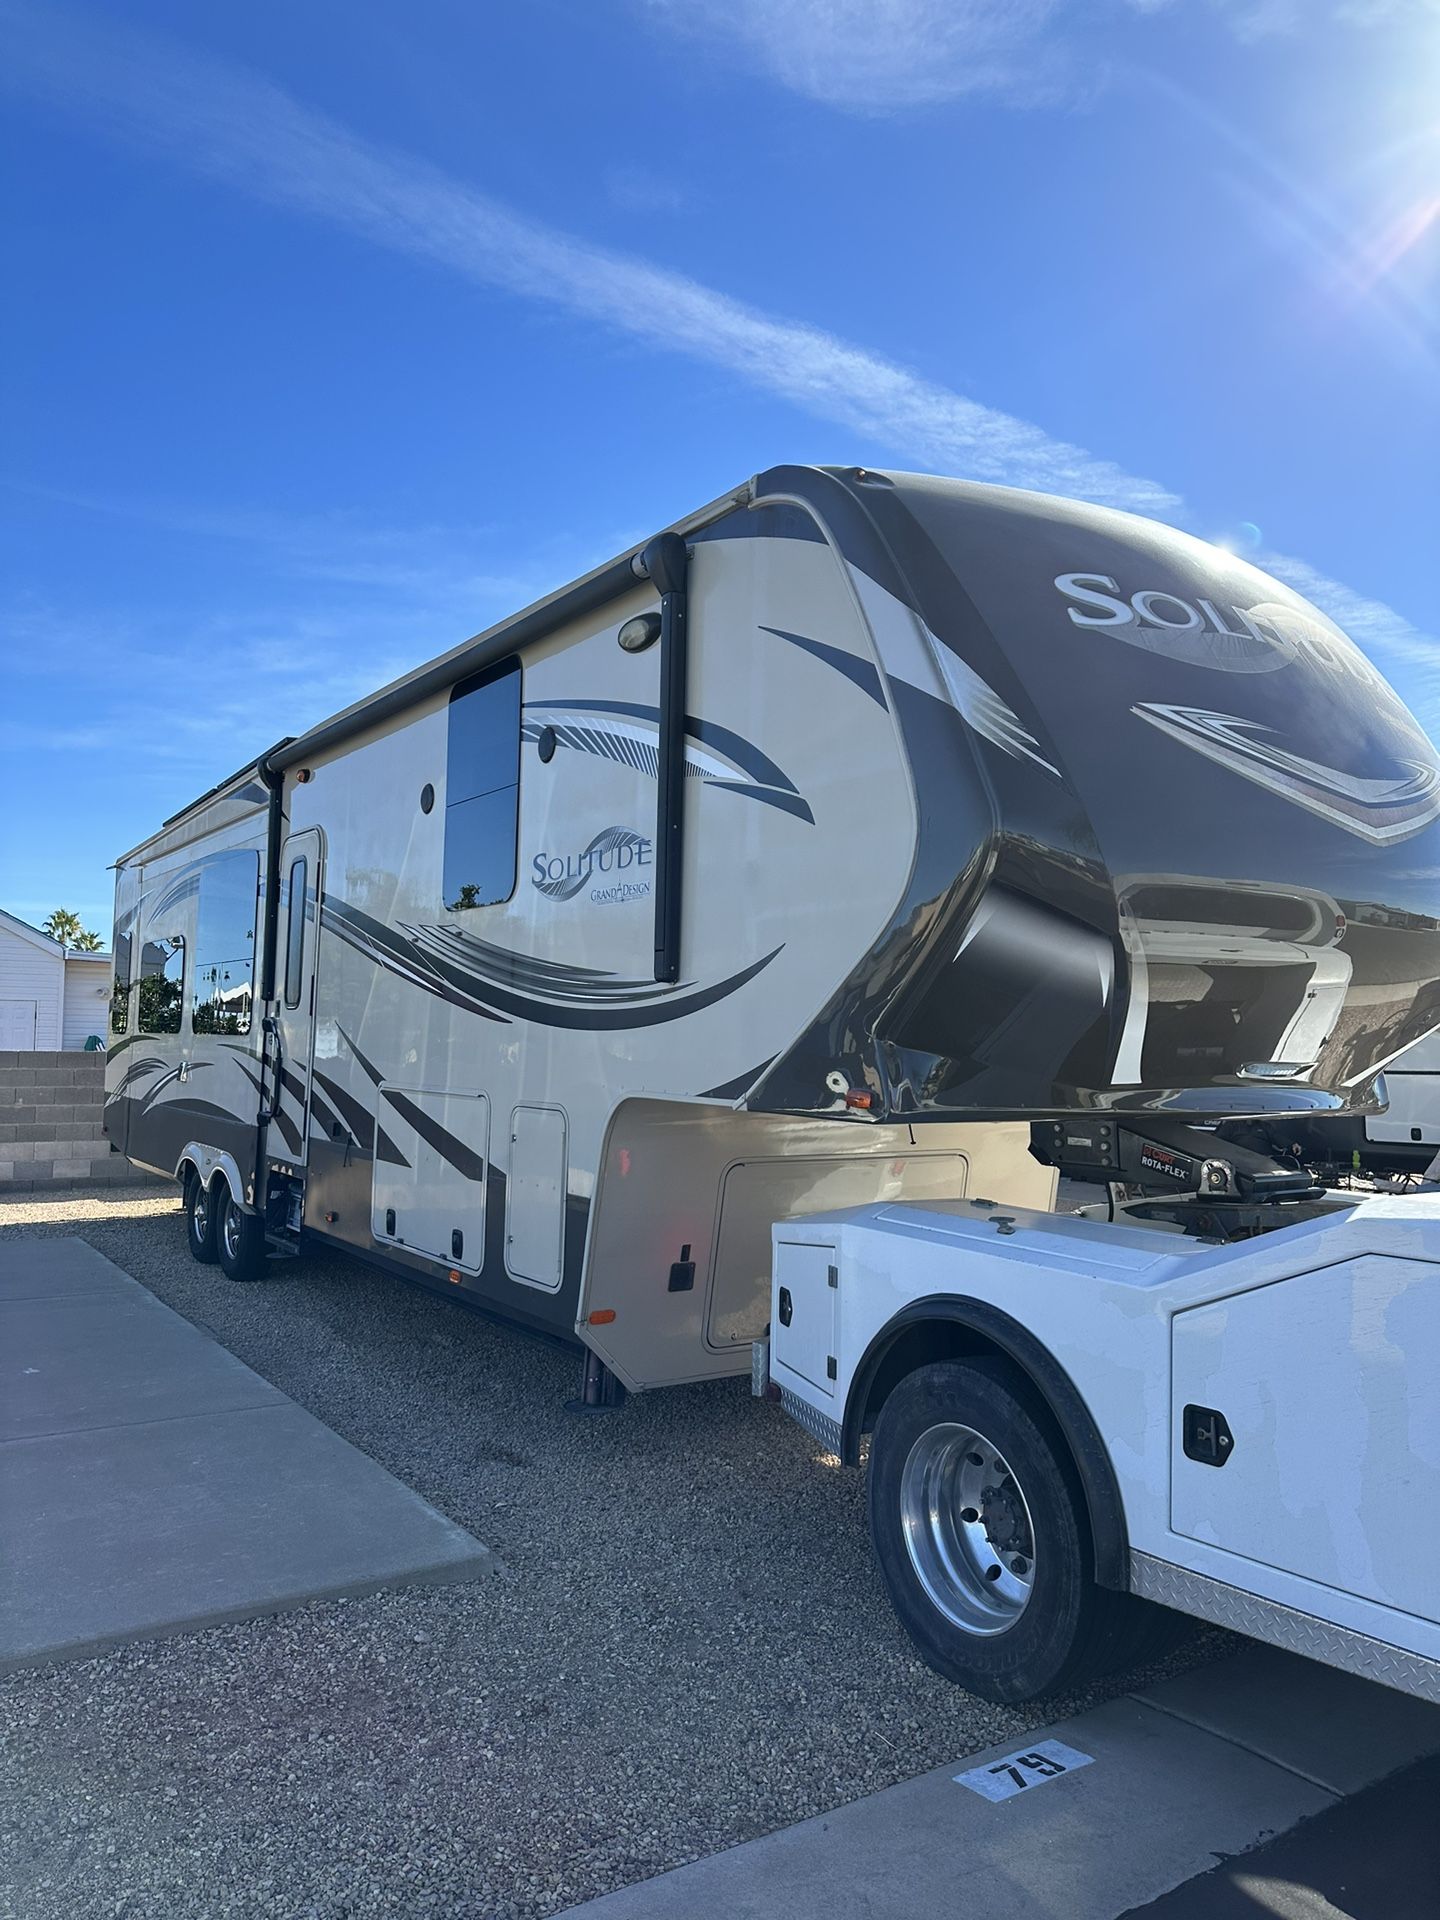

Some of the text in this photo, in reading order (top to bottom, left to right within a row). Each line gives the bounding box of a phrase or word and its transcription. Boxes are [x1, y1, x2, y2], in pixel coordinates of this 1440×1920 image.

[532, 839, 652, 884] SOLITUDE
[591, 888, 617, 902] GRAND
[623, 882, 650, 896] DESIGN
[1152, 1149, 1175, 1165] CURT
[988, 1752, 1066, 1789] 79
